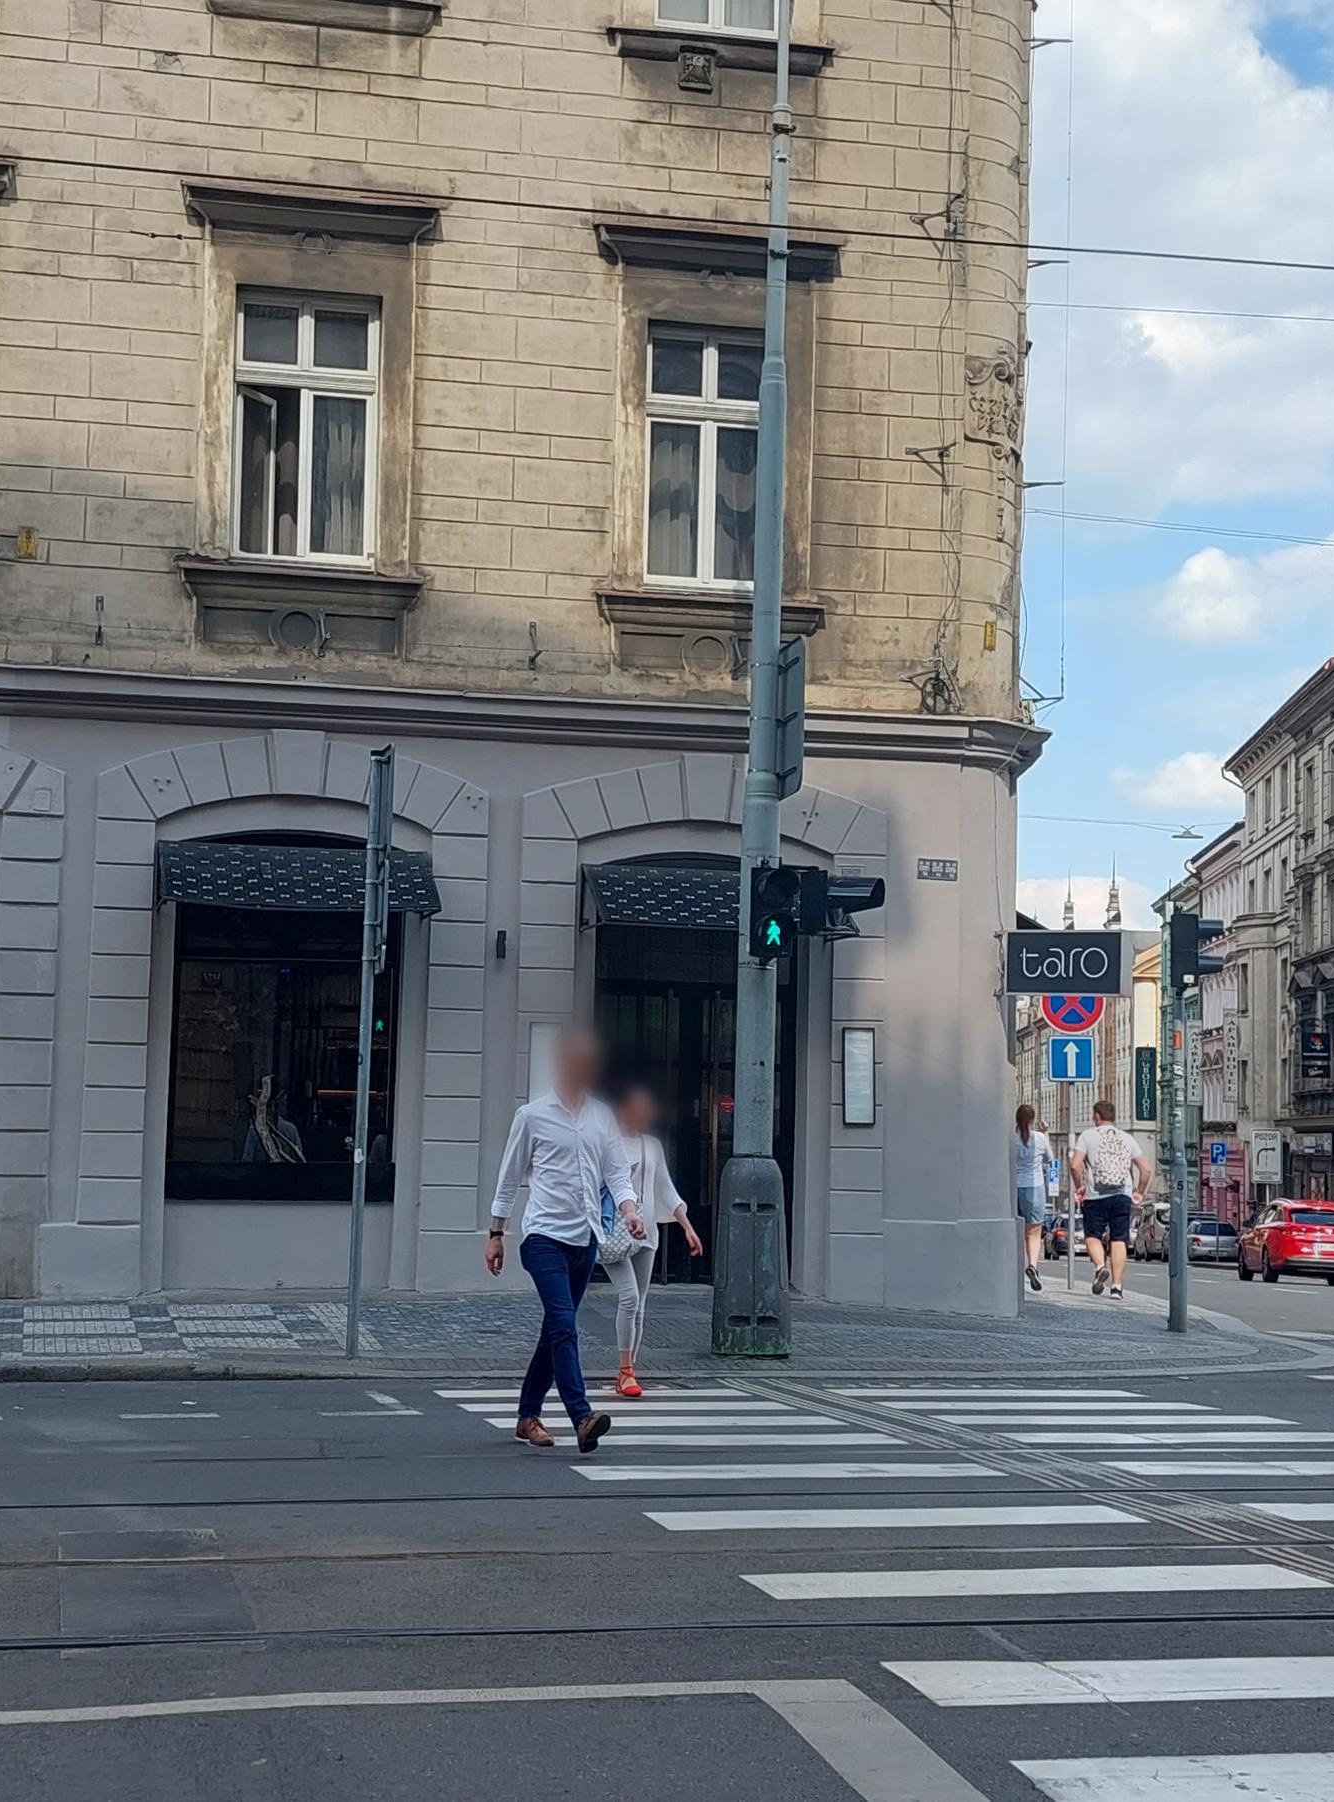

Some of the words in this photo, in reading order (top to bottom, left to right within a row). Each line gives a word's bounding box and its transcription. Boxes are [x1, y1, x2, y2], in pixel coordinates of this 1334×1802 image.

[1019, 947, 1108, 978] taro
[1213, 1145, 1222, 1158] P
[1177, 1181, 1184, 1191] 5
